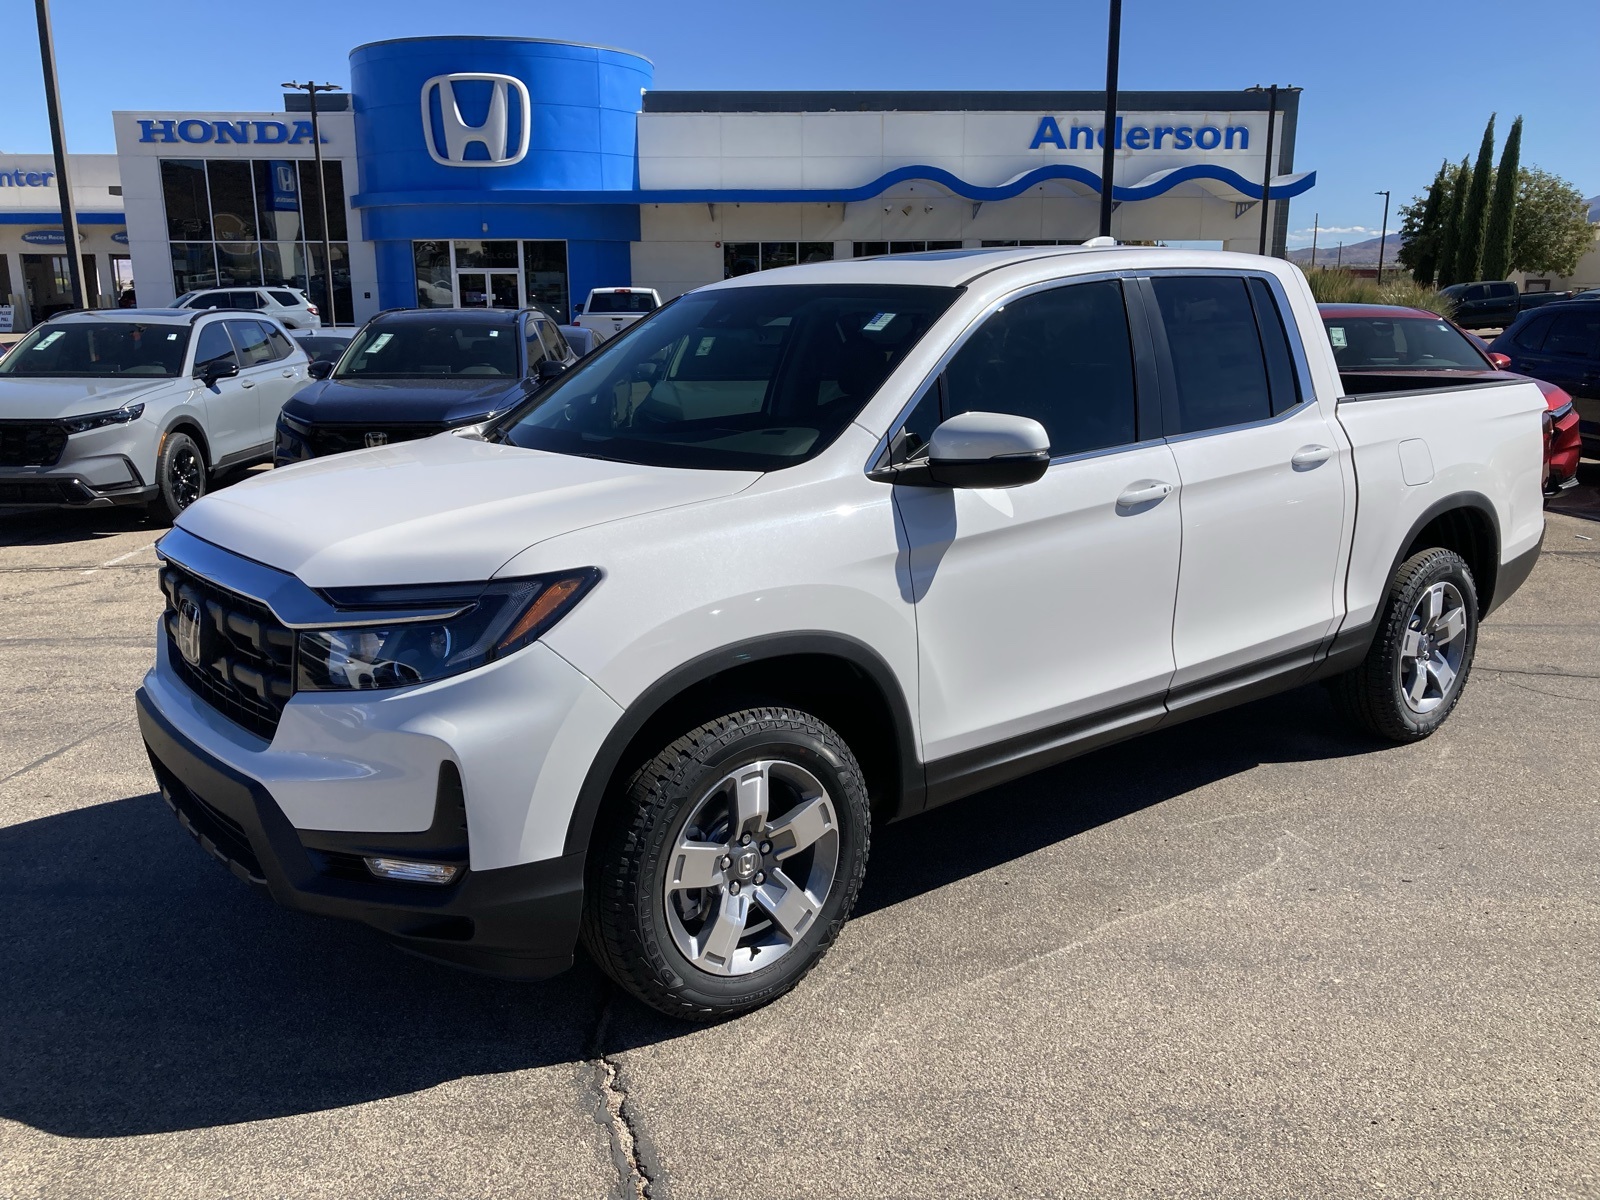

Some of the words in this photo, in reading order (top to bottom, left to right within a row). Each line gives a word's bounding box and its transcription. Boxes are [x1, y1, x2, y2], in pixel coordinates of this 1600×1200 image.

[137, 119, 328, 144] HONDA
[1029, 116, 1249, 150] Anderson
[0, 168, 54, 187] nter
